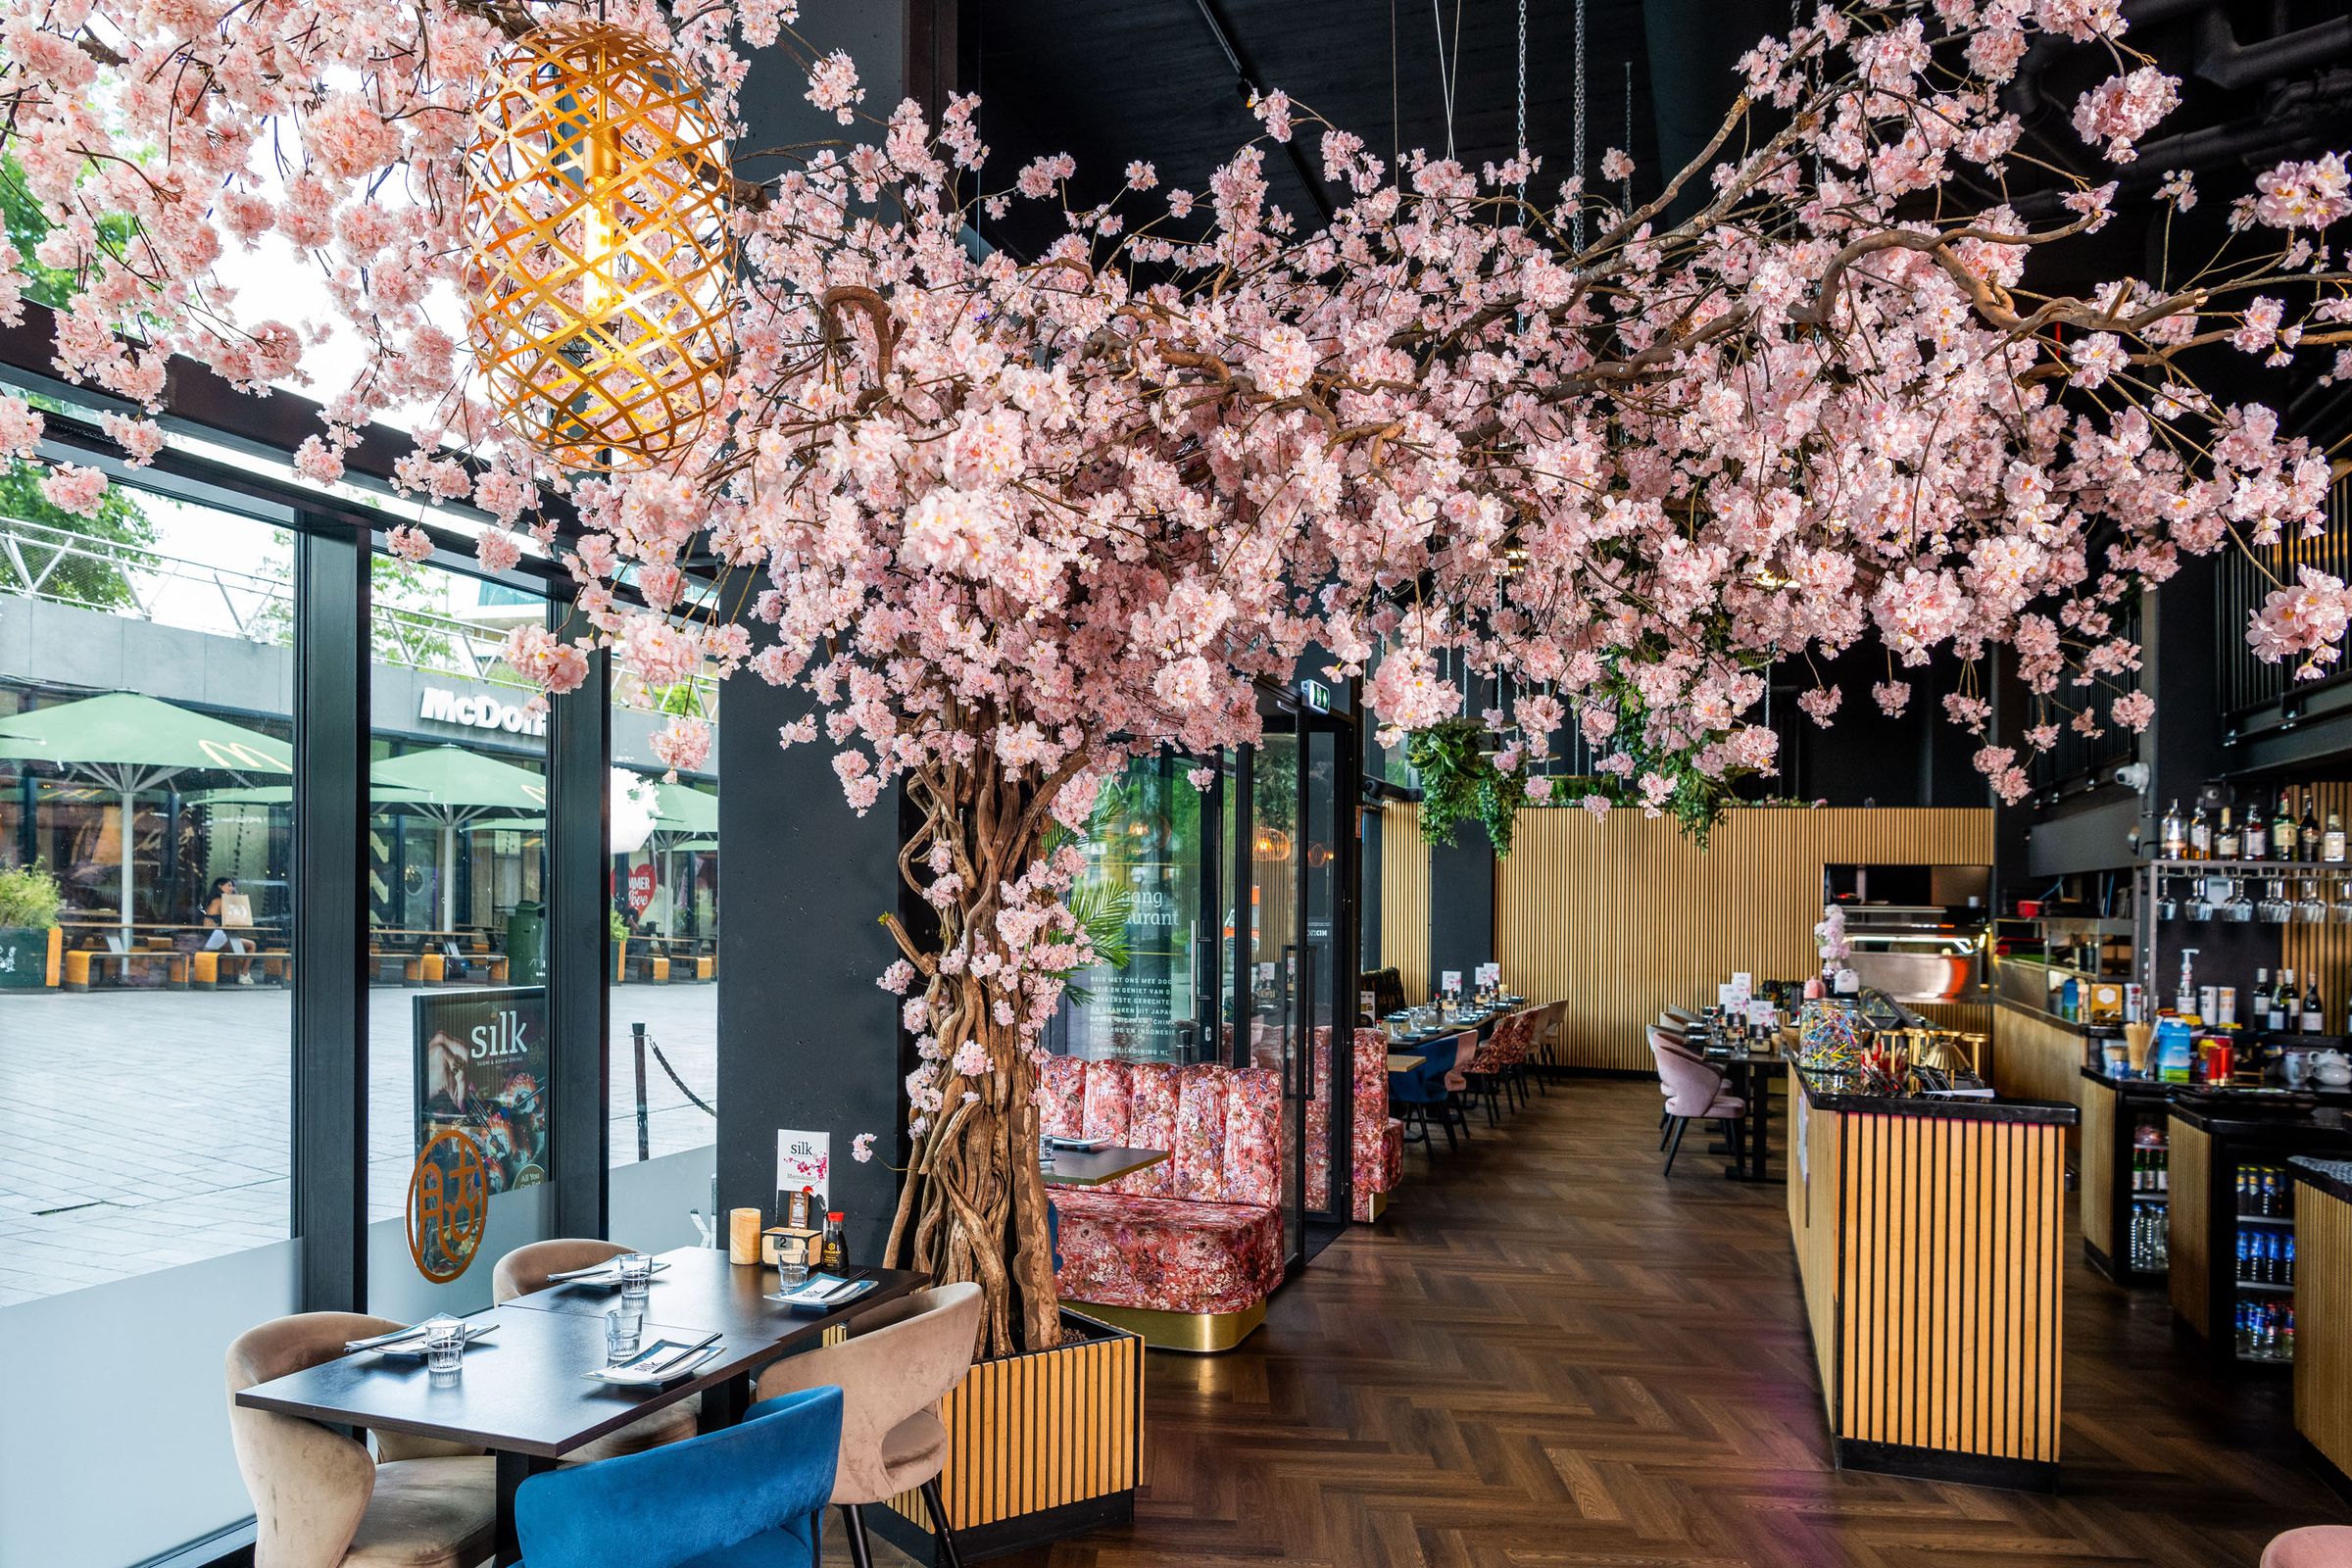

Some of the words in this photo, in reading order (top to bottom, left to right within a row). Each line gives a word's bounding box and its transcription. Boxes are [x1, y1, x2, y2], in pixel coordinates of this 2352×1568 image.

[419, 686, 547, 737] McDon
[628, 876, 651, 890] MMER
[1121, 890, 1163, 907] gang
[470, 1009, 528, 1058] silk
[790, 1141, 813, 1156] silk
[779, 1237, 787, 1249] 2
